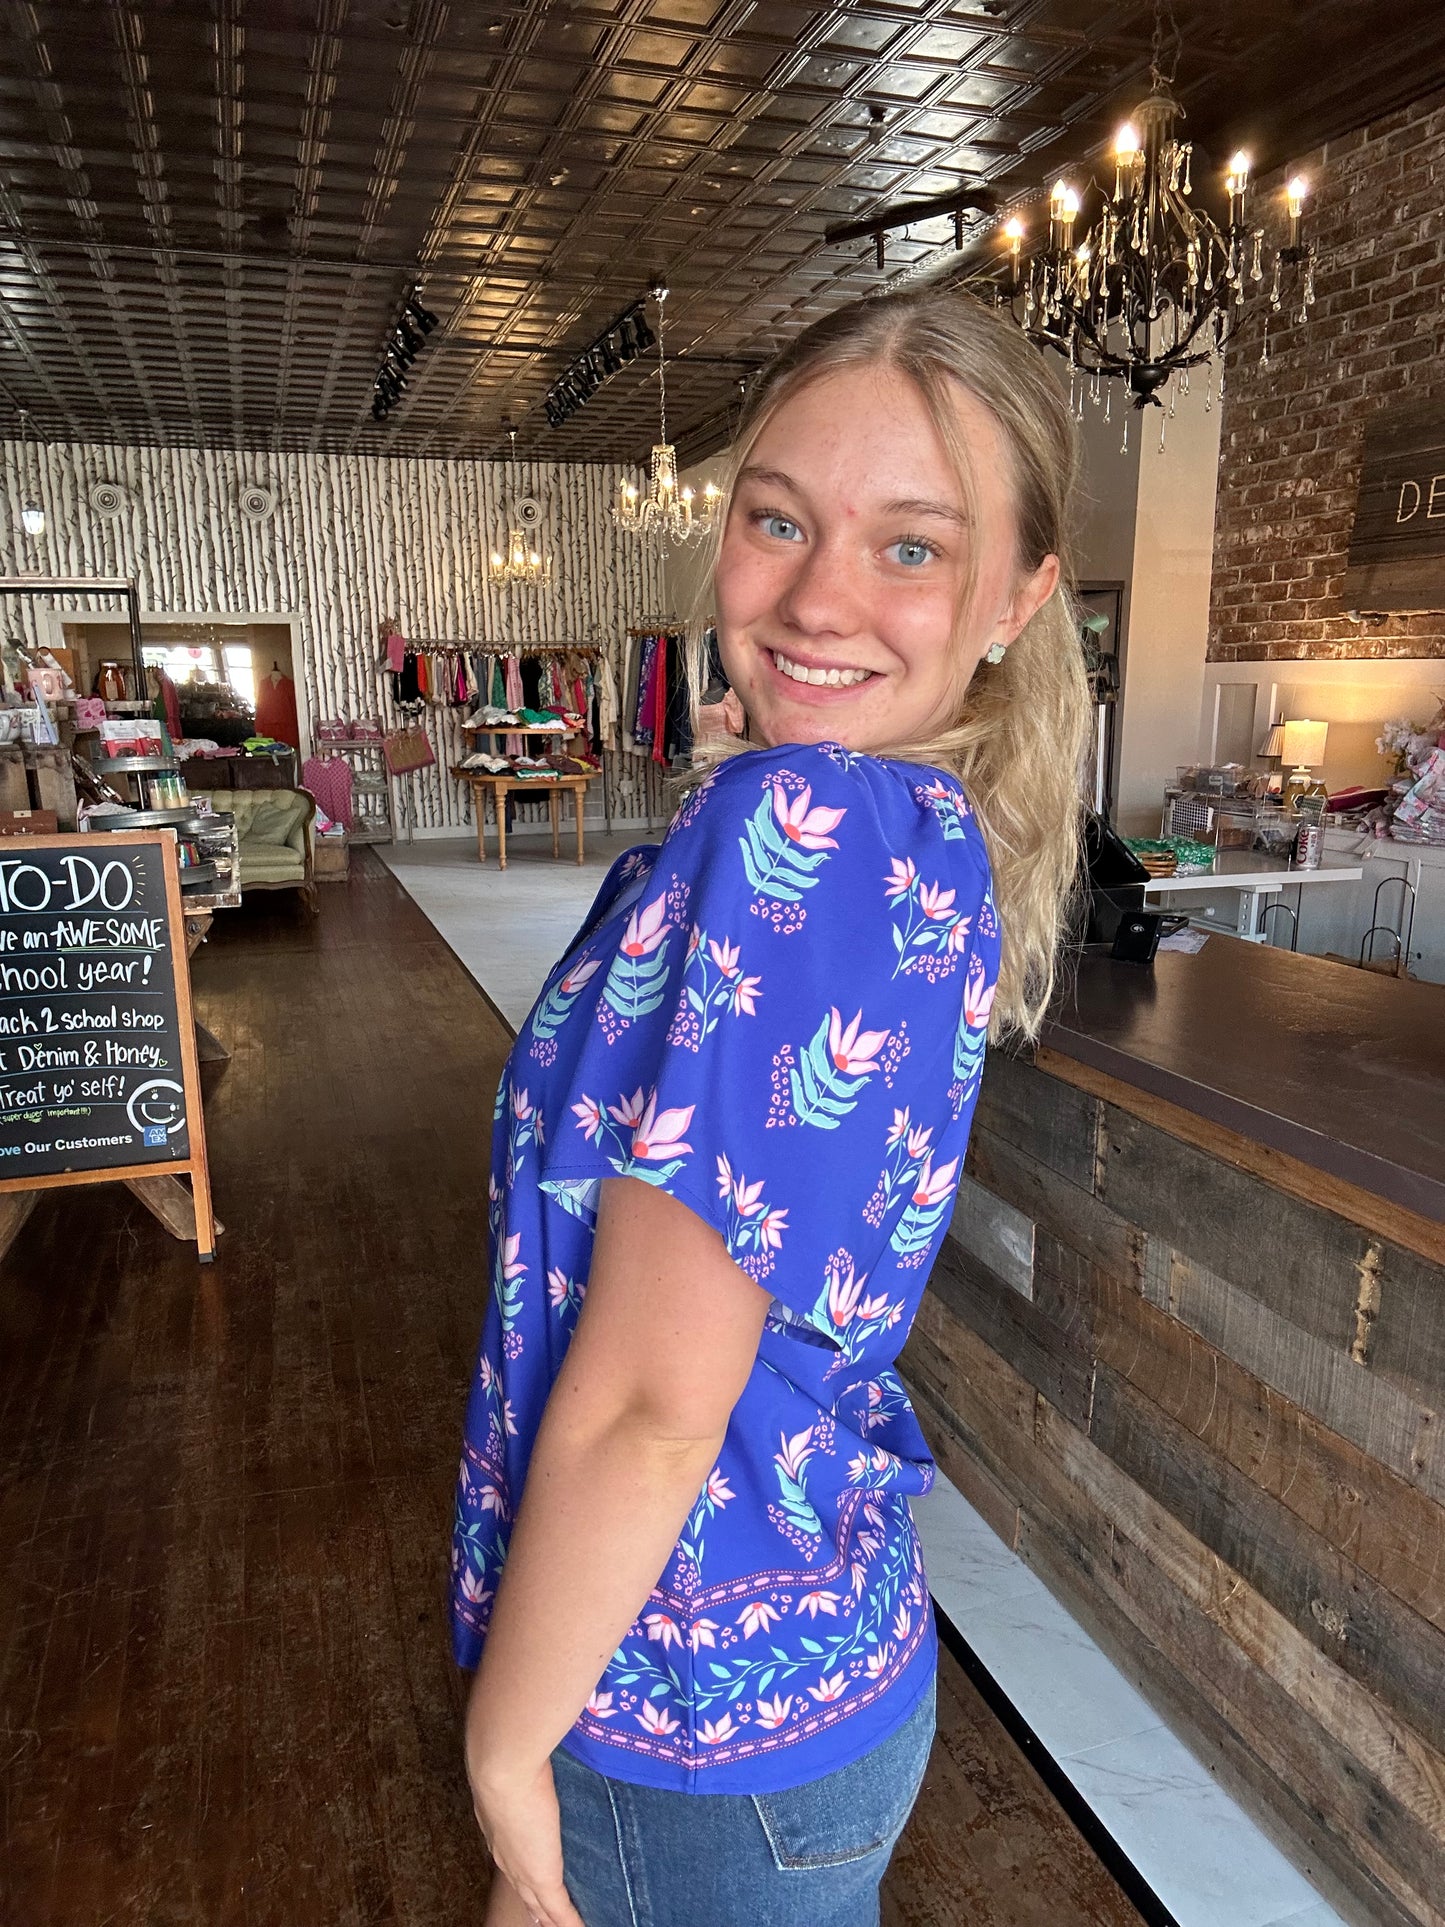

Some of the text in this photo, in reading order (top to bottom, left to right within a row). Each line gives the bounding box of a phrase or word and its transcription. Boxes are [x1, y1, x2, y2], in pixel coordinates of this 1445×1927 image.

[1396, 475, 1445, 523] DE
[1296, 829, 1310, 864] Coke
[0, 855, 133, 912] TO-DO
[23, 931, 49, 949] an
[50, 918, 166, 949] AWESOME
[0, 954, 152, 991] hool year!
[40, 1006, 59, 1033] 2
[60, 1005, 117, 1031] school
[121, 1008, 165, 1031] shop
[17, 1045, 80, 1071] Denim
[83, 1040, 102, 1067] &
[0, 1081, 47, 1109] Treat
[80, 1075, 126, 1099] self!
[24, 1141, 51, 1154] Our
[54, 1134, 133, 1151] Customers
